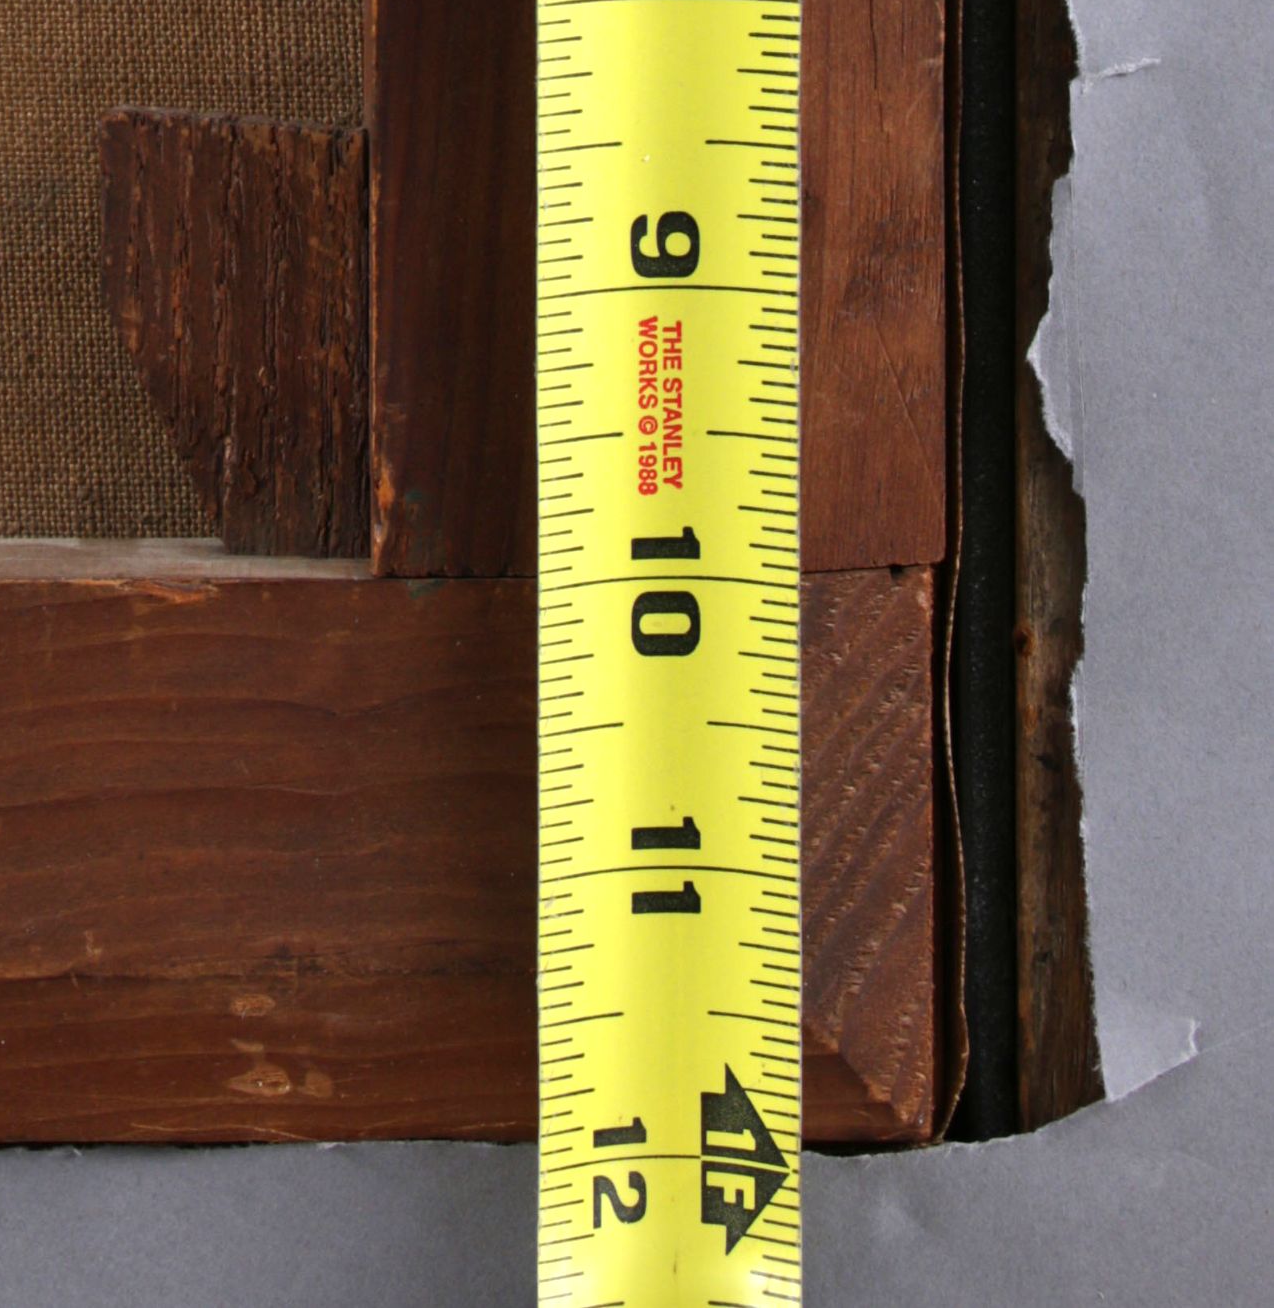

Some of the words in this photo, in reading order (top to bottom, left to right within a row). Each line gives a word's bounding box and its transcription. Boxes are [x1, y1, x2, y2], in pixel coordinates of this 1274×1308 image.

[630, 210, 701, 279] 9
[637, 316, 659, 410] WORKS
[662, 320, 683, 371] THE
[637, 442, 659, 497] 1988
[661, 377, 684, 489] STANLEY
[631, 526, 701, 657] 10
[631, 816, 702, 915] 11
[593, 1117, 647, 1229] 12
